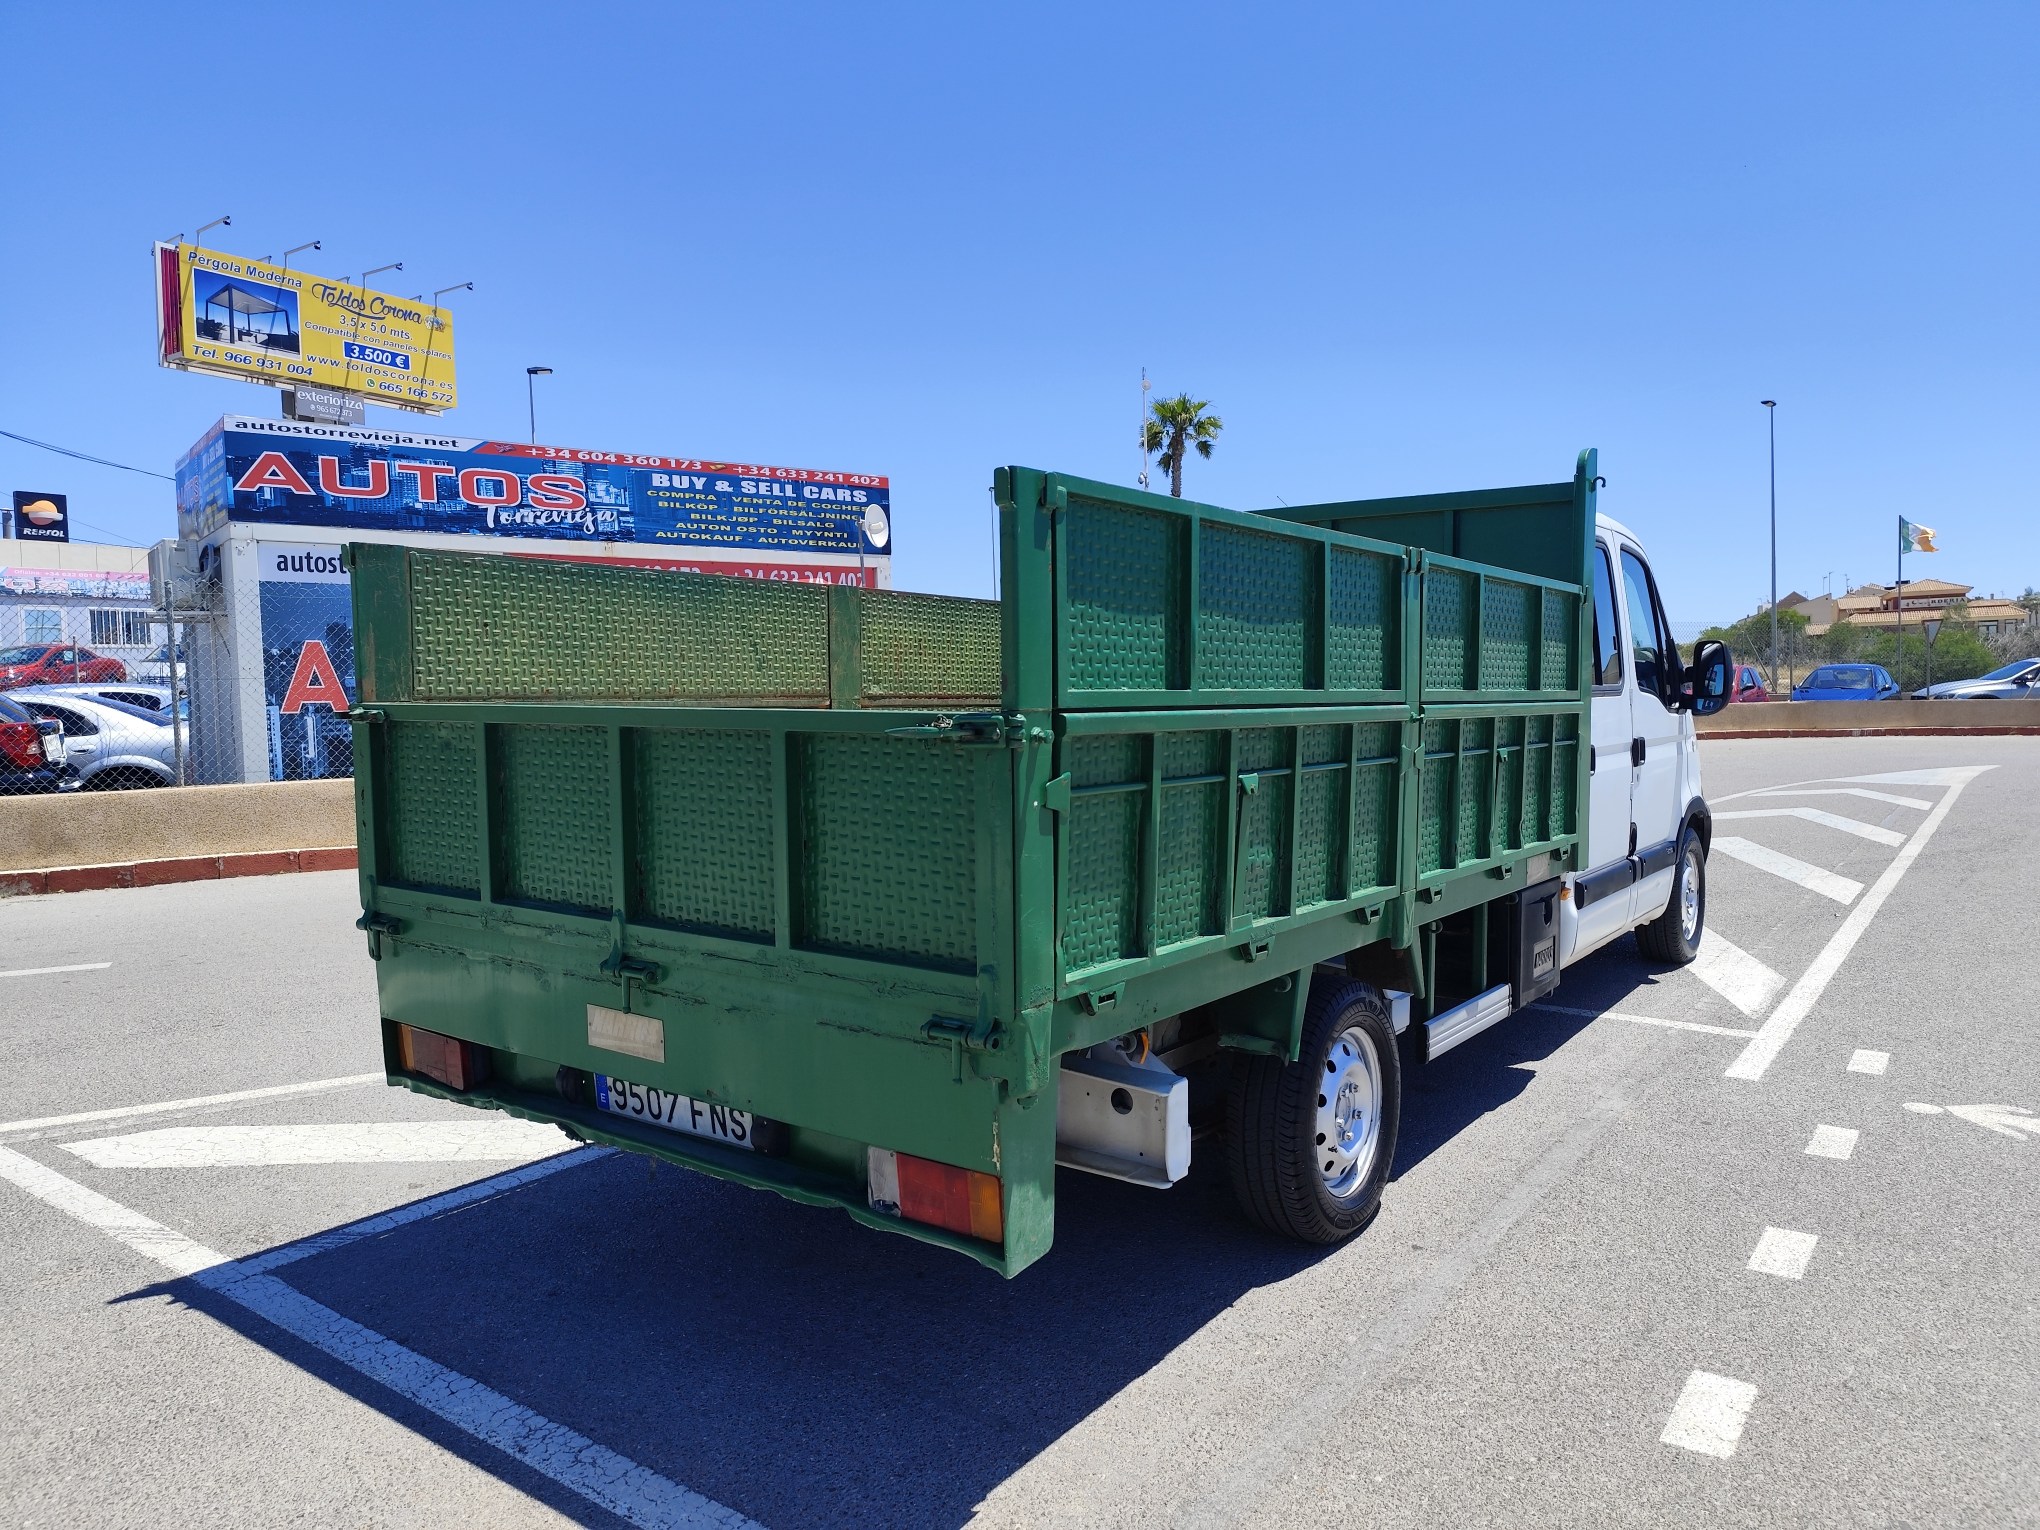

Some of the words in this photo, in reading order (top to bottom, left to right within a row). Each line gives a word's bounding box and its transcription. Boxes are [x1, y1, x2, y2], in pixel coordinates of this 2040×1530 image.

[188, 251, 241, 274] Pérgola
[246, 265, 302, 288] Moderna
[312, 283, 366, 320] Toldos
[370, 296, 422, 324] Corona
[305, 321, 361, 340] Compatible
[363, 335, 380, 344] con
[383, 340, 418, 353] paneles
[420, 348, 452, 361] solares
[340, 315, 357, 327] 3,5
[360, 321, 366, 329] x
[370, 322, 387, 334] 5,0
[390, 328, 413, 341] mts.
[192, 345, 219, 359] Tel.
[224, 351, 252, 365] 966
[257, 358, 282, 371] 931
[287, 364, 313, 376] 004
[350, 346, 392, 364] 3.500
[396, 355, 406, 368] €
[306, 354, 453, 390] www.toldoscorona.es
[297, 390, 364, 410] exterioriza
[379, 382, 403, 394] 665
[407, 388, 428, 399] 166
[431, 392, 453, 403] 572
[316, 404, 329, 412] 965
[235, 420, 459, 448] autostorrevieja.net
[525, 447, 571, 459] +34
[577, 451, 617, 463] 604
[623, 455, 661, 466] 360
[667, 459, 702, 470] 173
[733, 466, 771, 475] +34
[776, 469, 808, 479] 633
[813, 472, 844, 482] 241
[849, 476, 880, 486] 402
[233, 450, 587, 511] AUTOS
[652, 473, 707, 490] BUY
[714, 480, 733, 492] &
[740, 480, 797, 498] SELL
[803, 485, 868, 503] CARS
[647, 490, 717, 501] COMPRA
[732, 496, 783, 506] VENTA
[787, 500, 806, 508] DE
[658, 501, 718, 511] BILKÖP
[479, 503, 616, 535] Torrevieja
[676, 522, 731, 531] AUTON
[736, 526, 778, 534] OSTO
[791, 529, 848, 538] MYYNTI
[690, 513, 758, 523] BILKJØP
[773, 518, 835, 528] BILSALG
[23, 528, 65, 537] REPSOL
[656, 531, 743, 541] AUTOKAUF
[600, 1092, 607, 1104] E
[612, 1079, 678, 1123] 9507
[689, 1097, 747, 1141] FNS
